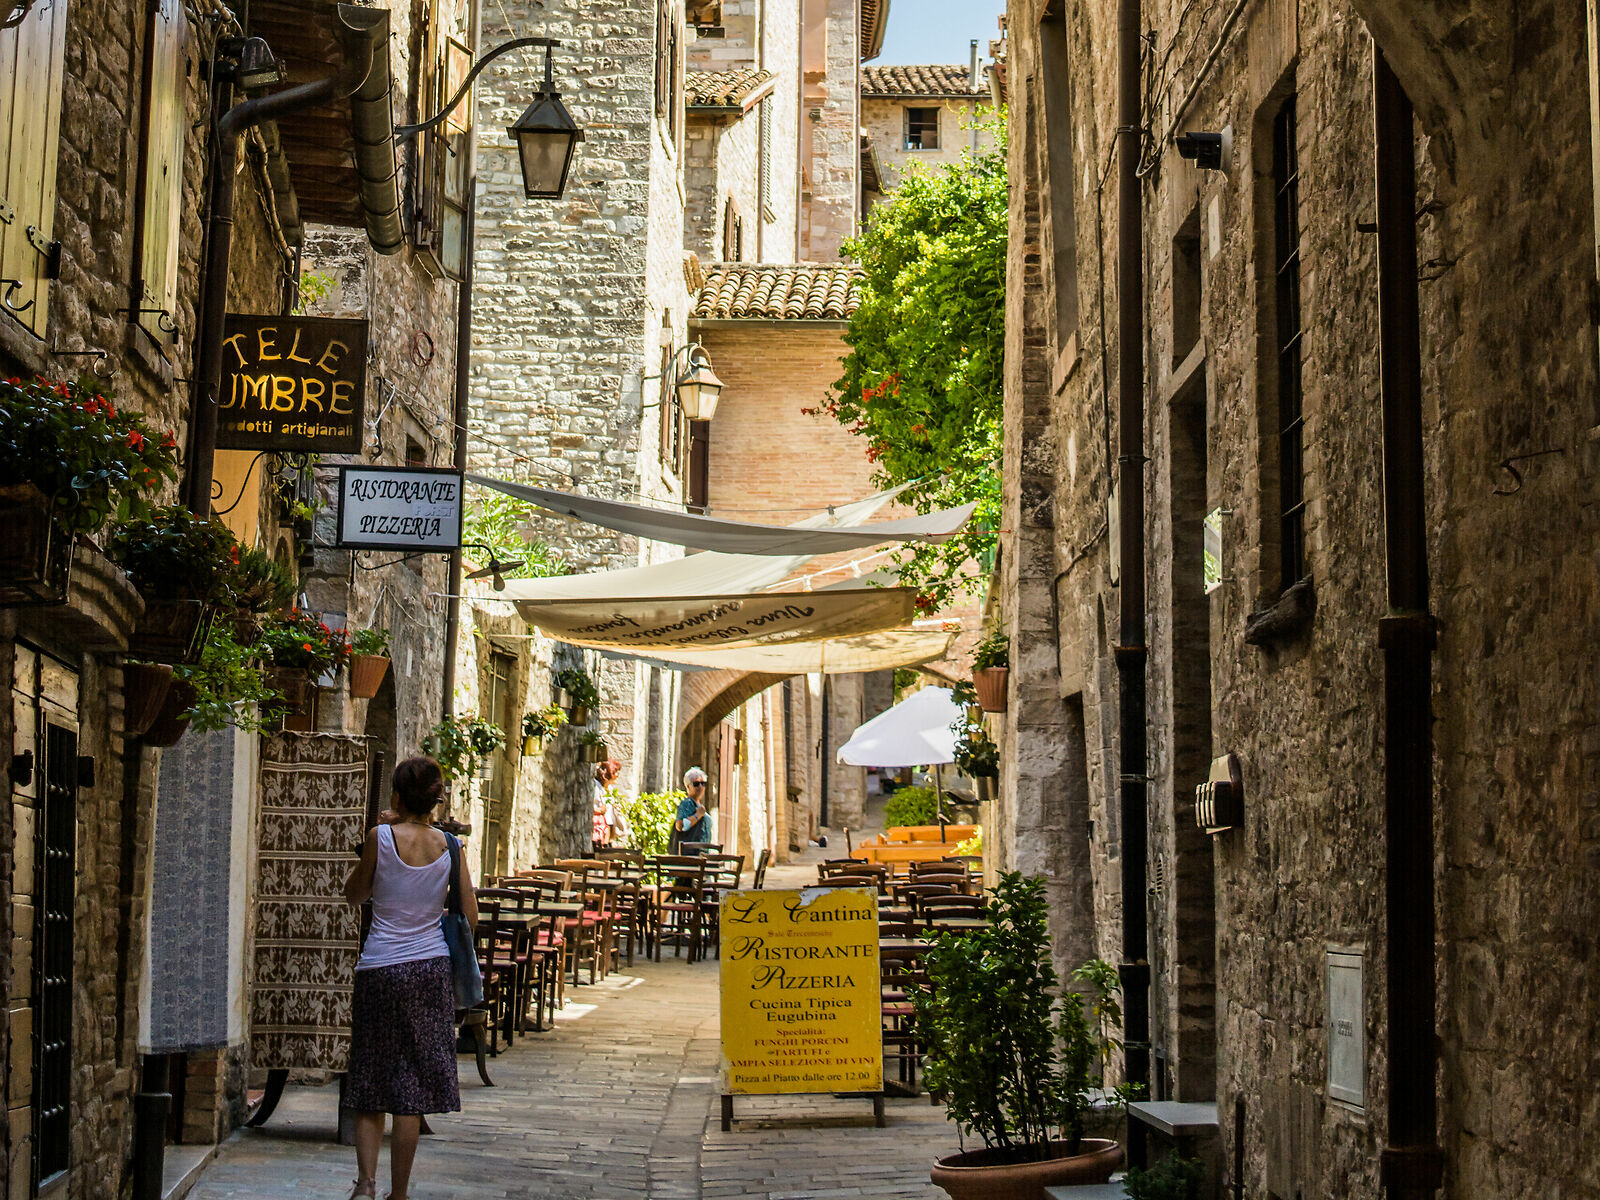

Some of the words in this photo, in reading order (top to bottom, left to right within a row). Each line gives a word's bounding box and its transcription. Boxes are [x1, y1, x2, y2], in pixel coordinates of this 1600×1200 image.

[222, 327, 350, 375] TELE
[281, 422, 353, 438] artigianali
[351, 478, 456, 505] RISTORANTE
[359, 514, 442, 540] PIZZERIA
[728, 899, 768, 924] La
[783, 898, 872, 924] Cantina
[730, 936, 873, 961] RISTORANTE
[751, 965, 856, 990] PIZZERIA
[750, 999, 801, 1010] Cucina
[808, 998, 852, 1010] Tipica
[766, 1011, 836, 1024] Eugubina
[754, 1038, 798, 1047] FUNGHI
[801, 1037, 849, 1046] PORCINI
[730, 1059, 766, 1068] AMPIA
[768, 1058, 833, 1067] SELEZIONE
[835, 1057, 848, 1066] DI
[850, 1057, 875, 1065] VINI
[735, 1074, 760, 1084] Pizza
[762, 1073, 771, 1083] al
[773, 1073, 800, 1083] Piatto
[802, 1072, 825, 1082] dalle
[827, 1074, 843, 1082] ore
[844, 1071, 871, 1081] 12.00
